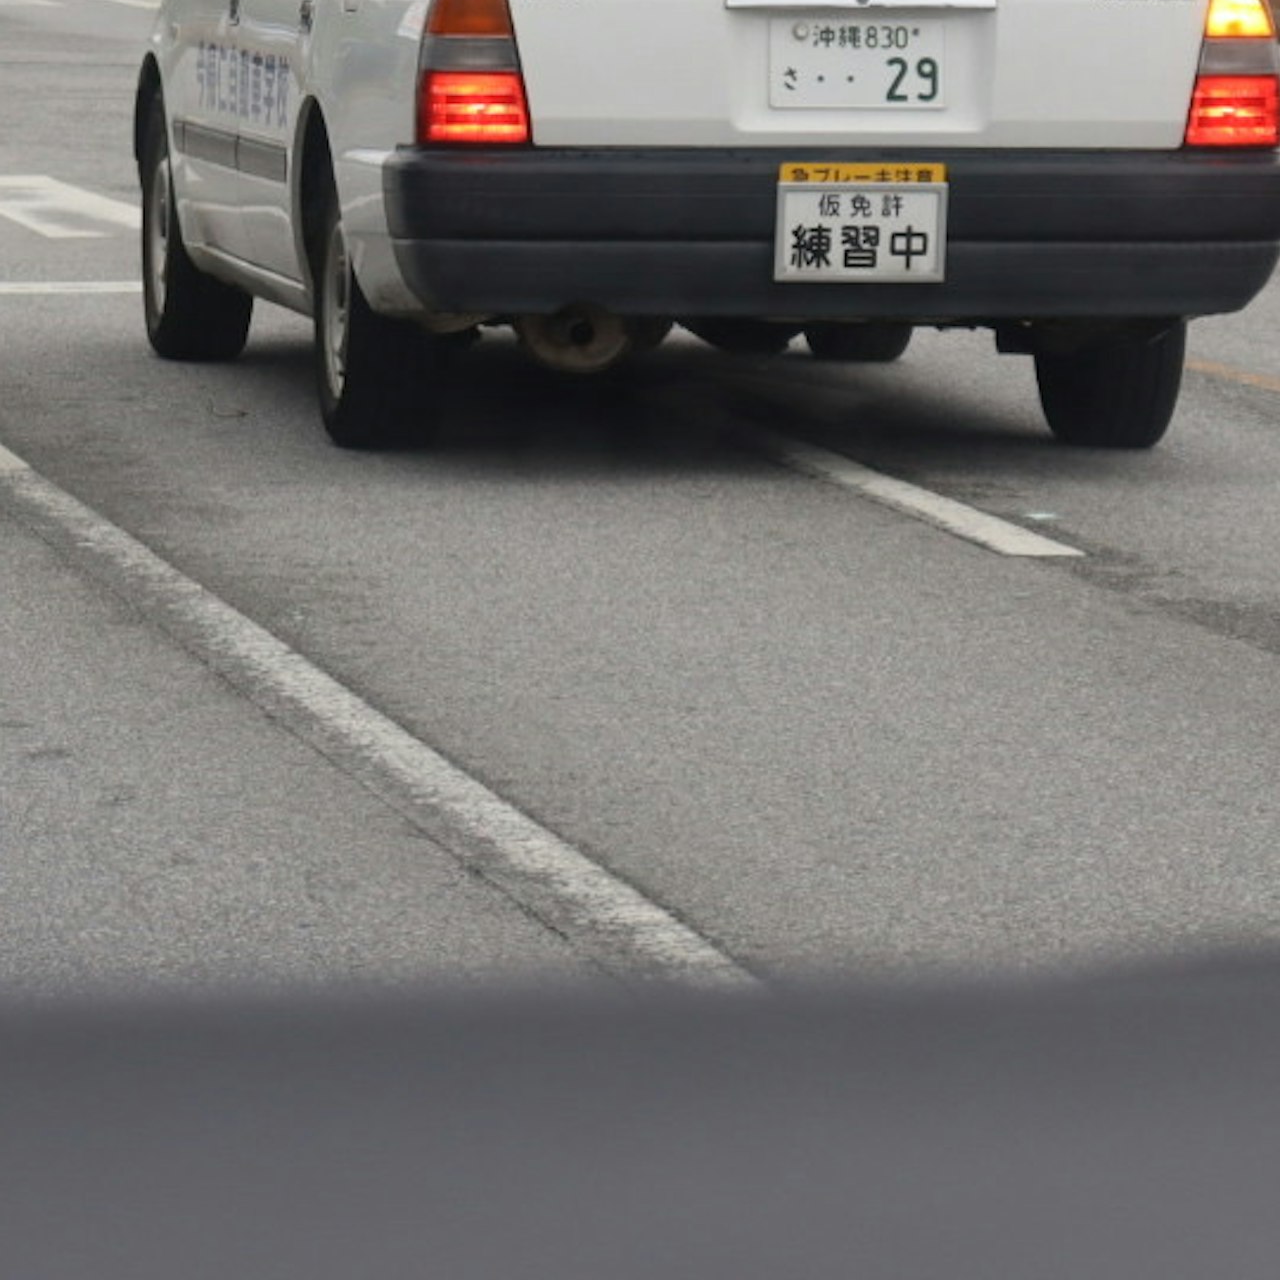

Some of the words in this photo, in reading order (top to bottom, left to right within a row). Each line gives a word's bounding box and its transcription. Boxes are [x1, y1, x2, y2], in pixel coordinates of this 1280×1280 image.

[818, 193, 904, 218] 仮免許
[790, 223, 928, 271] 練習中
